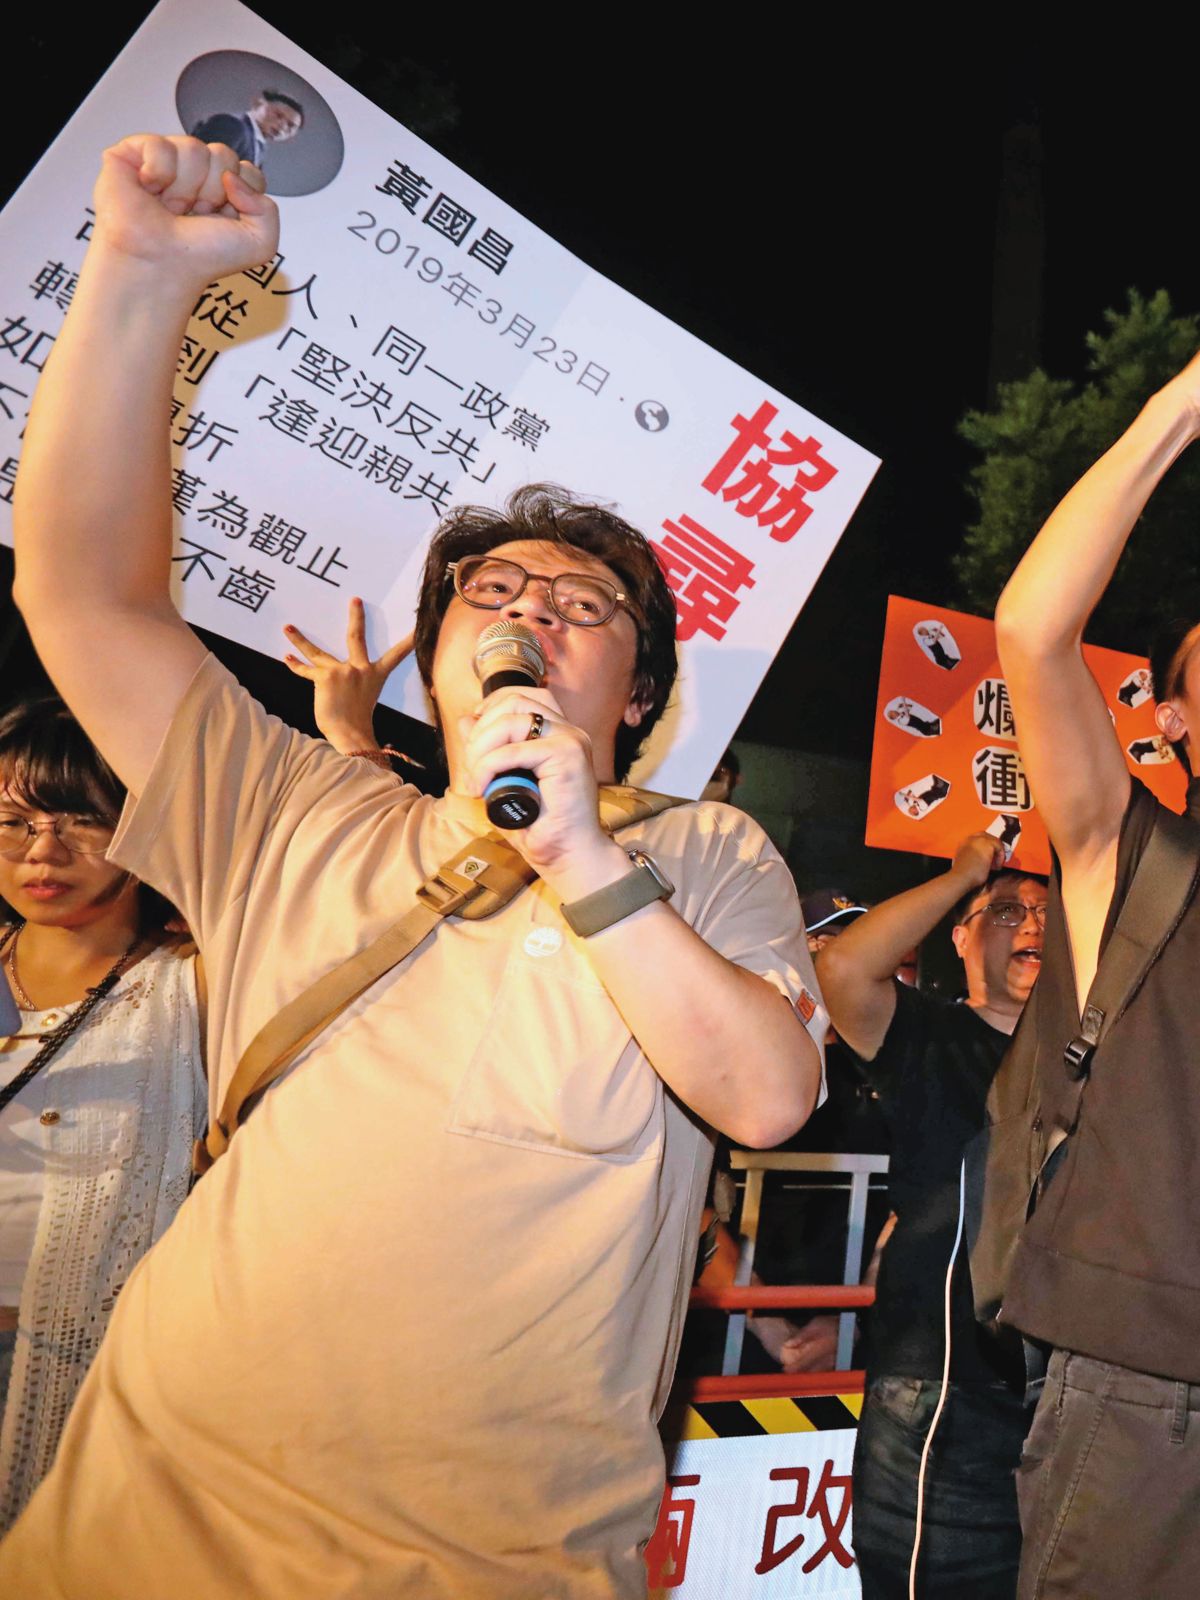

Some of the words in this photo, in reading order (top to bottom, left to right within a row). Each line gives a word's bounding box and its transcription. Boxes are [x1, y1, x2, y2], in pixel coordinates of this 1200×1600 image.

[347, 211, 611, 396] 2019年3月23日
[375, 160, 515, 276] 黃國昌
[645, 400, 839, 643] 協尋
